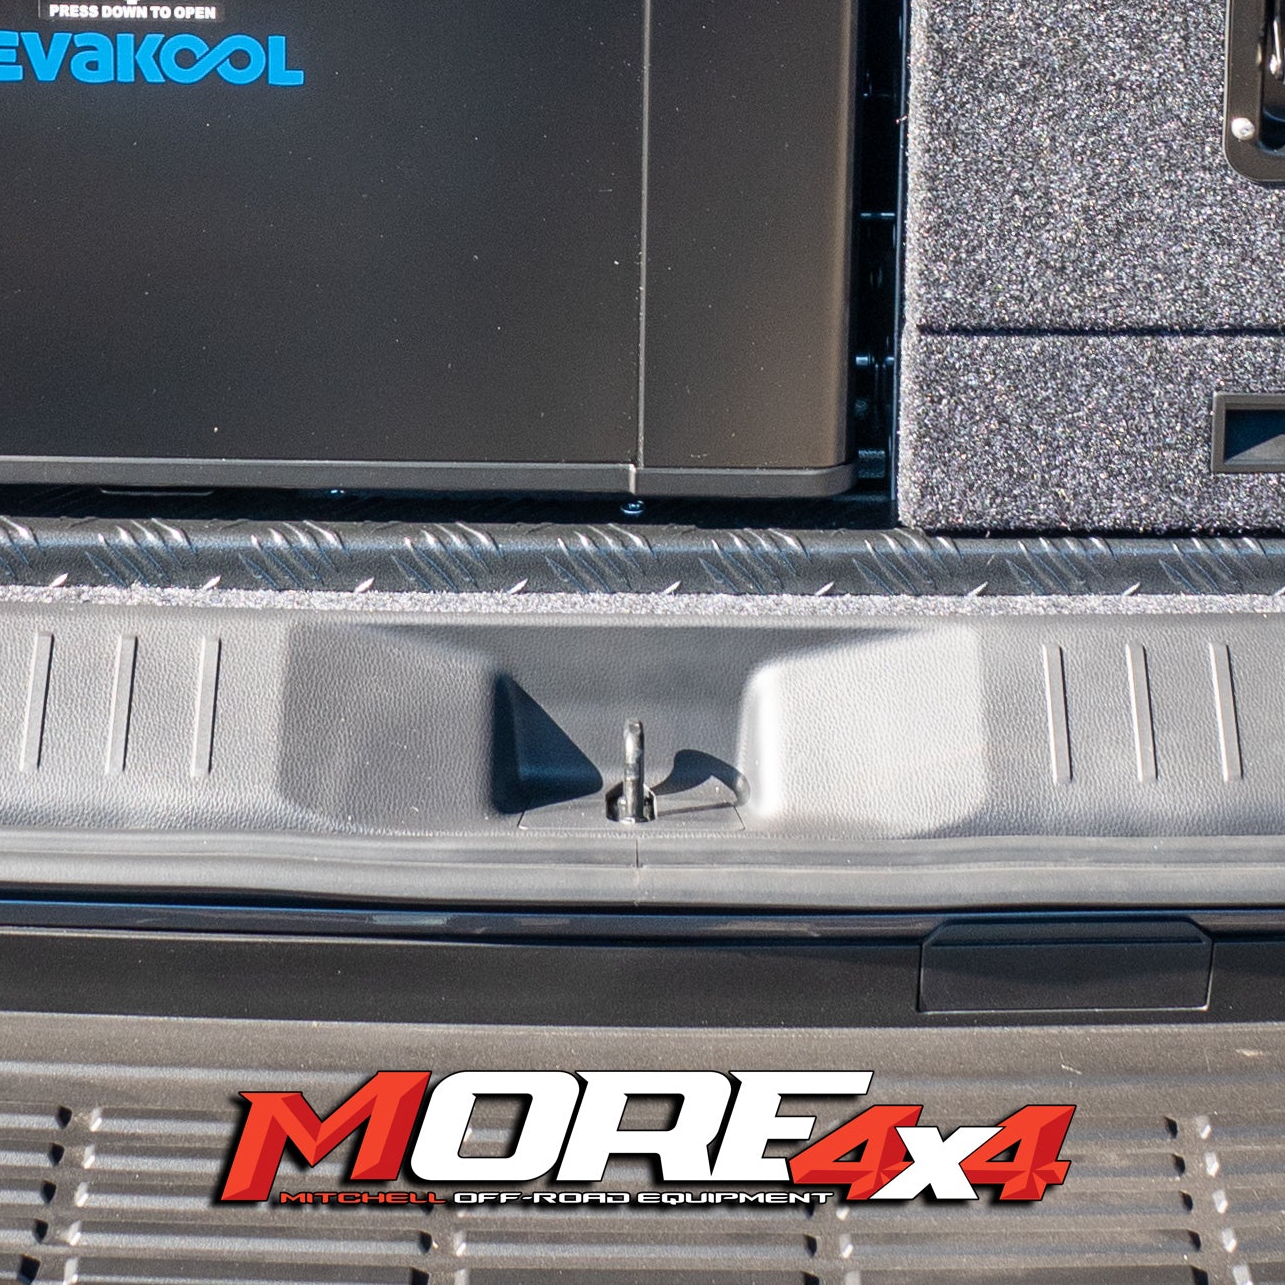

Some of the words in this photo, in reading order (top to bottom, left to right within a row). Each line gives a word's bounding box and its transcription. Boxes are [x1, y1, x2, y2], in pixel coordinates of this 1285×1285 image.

[49, 4, 100, 18] PRESS
[101, 5, 148, 19] DOWN
[150, 6, 172, 19] TO
[173, 6, 217, 20] OPEN
